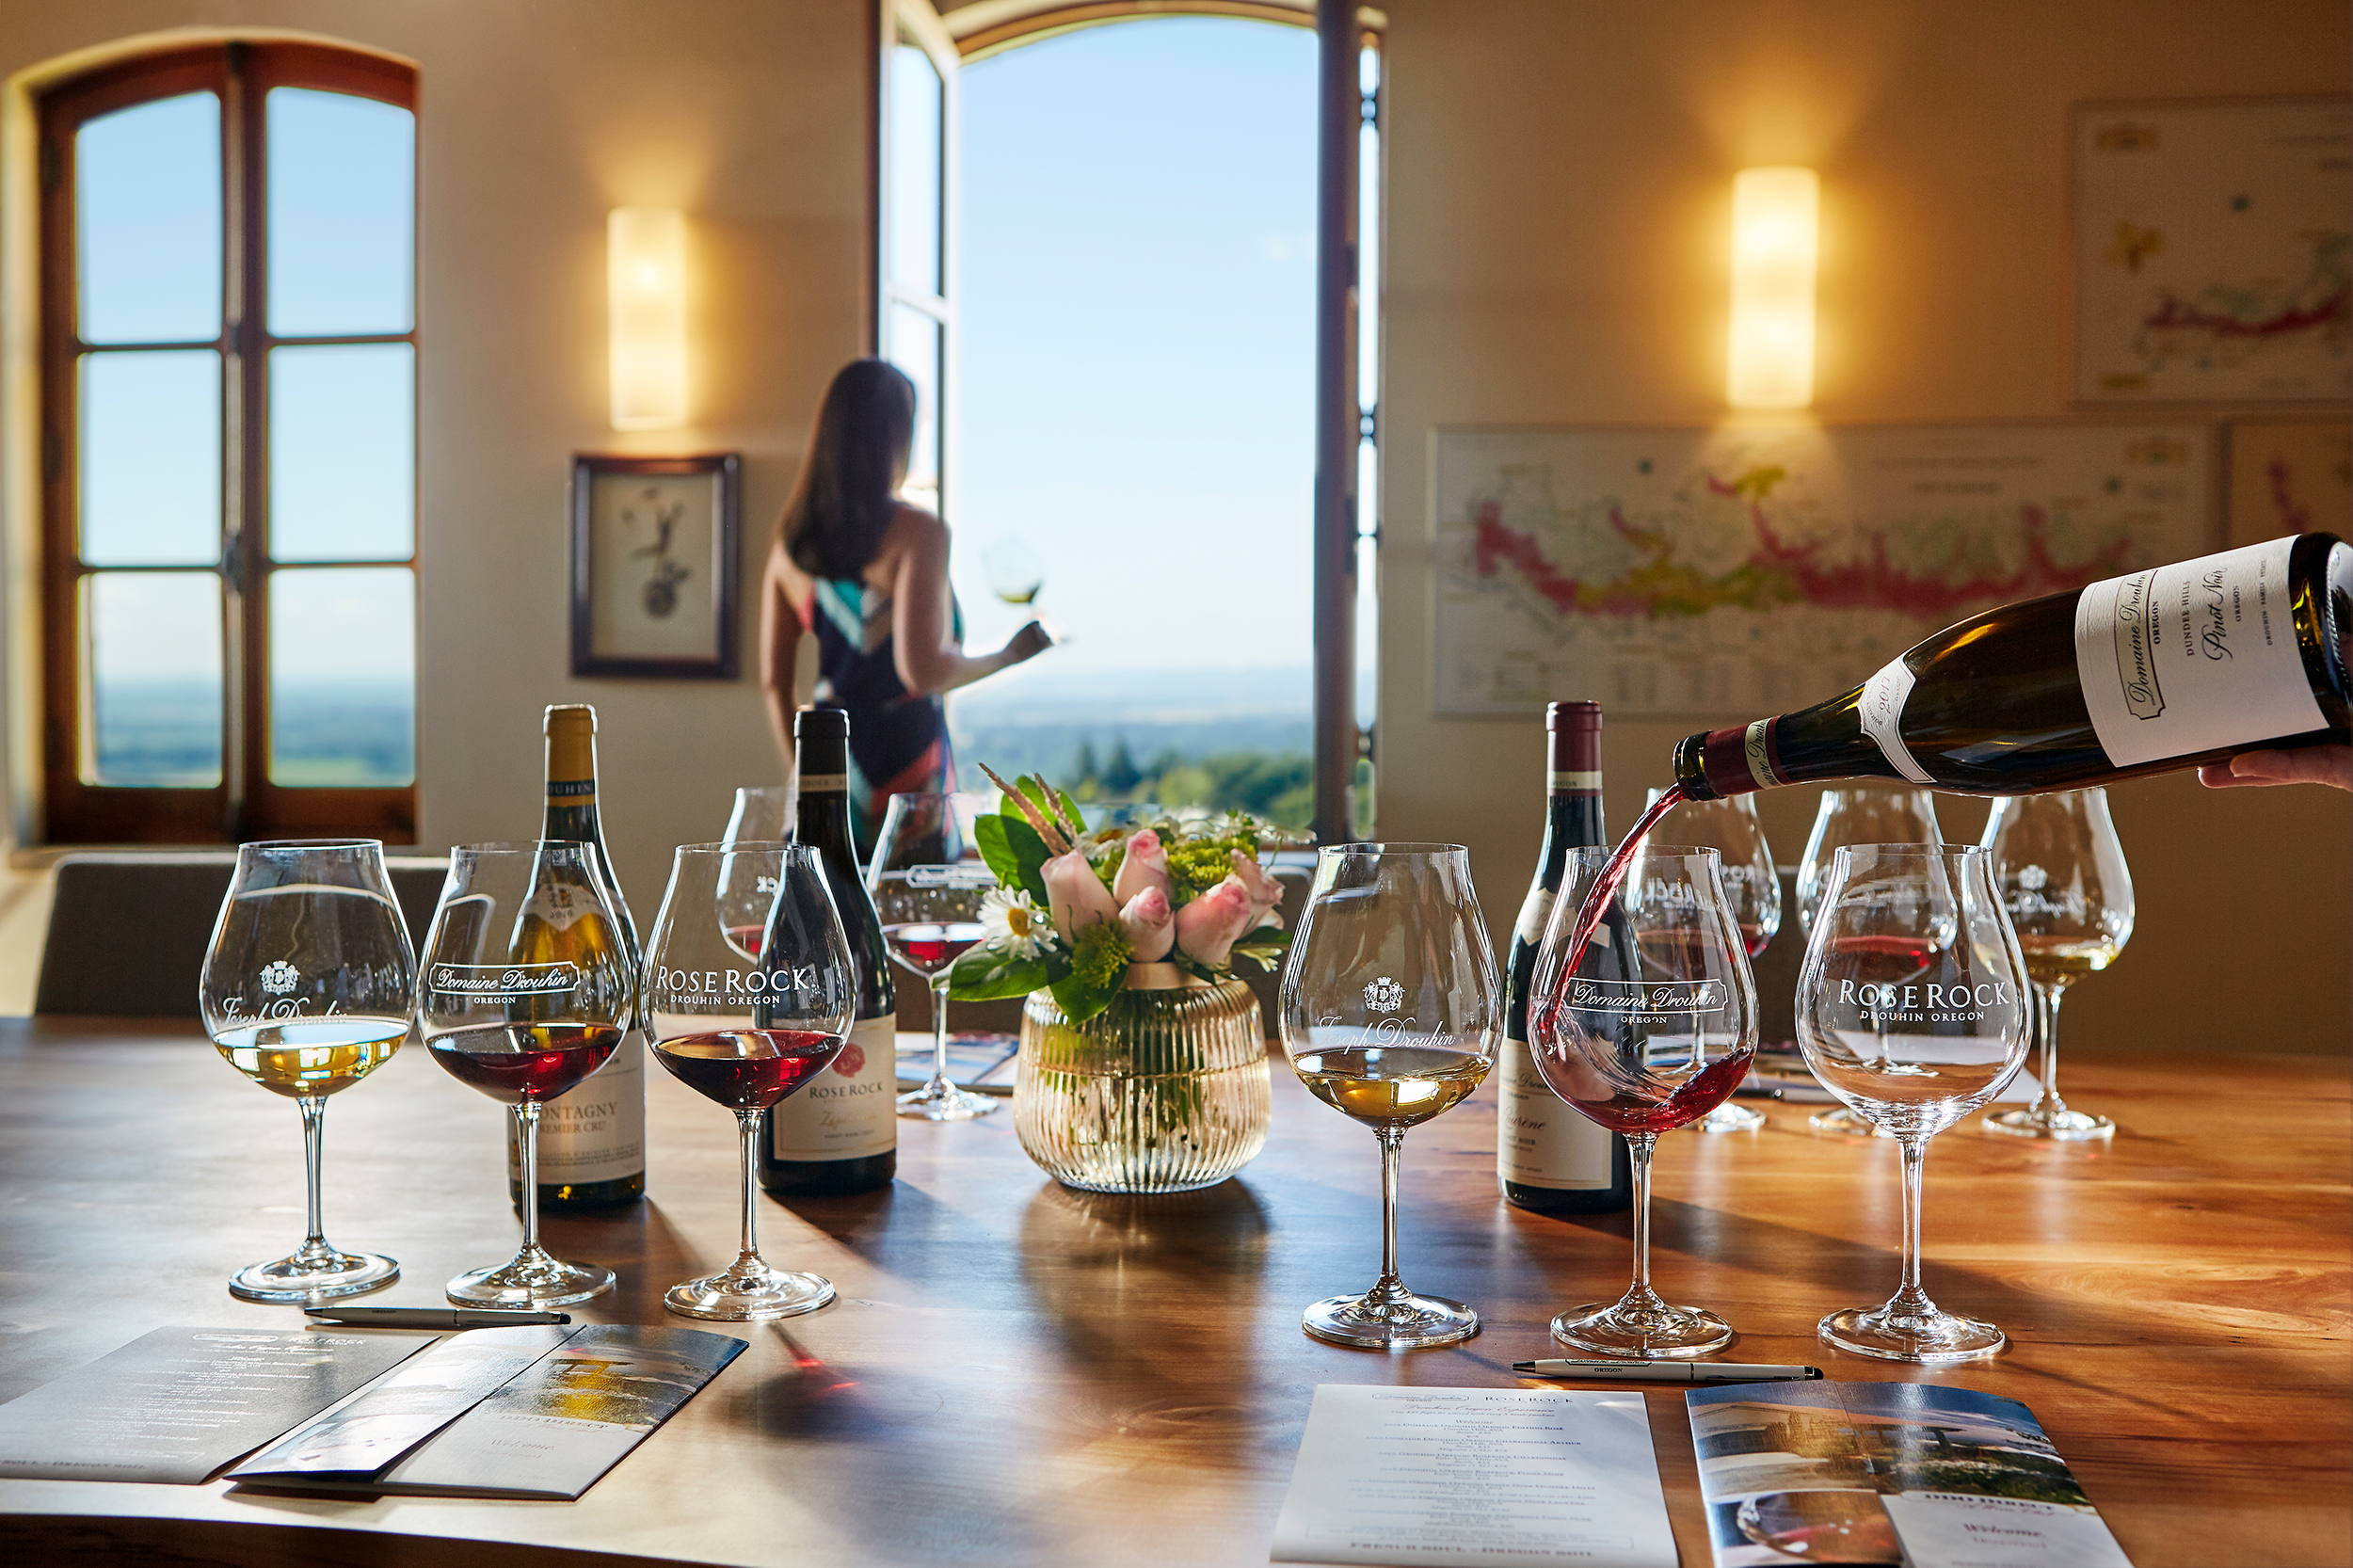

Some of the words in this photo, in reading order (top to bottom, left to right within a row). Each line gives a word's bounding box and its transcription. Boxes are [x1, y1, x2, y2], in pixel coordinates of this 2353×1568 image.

[2182, 581, 2191, 607] HILLS
[2202, 568, 2228, 605] Noir
[2233, 584, 2242, 622] OREGON
[2153, 600, 2161, 645] OREGON
[2182, 609, 2195, 657] DUNDEE
[2201, 603, 2233, 662] Pinot
[2128, 626, 2155, 706] Domaine
[1879, 676, 1892, 714] 2017
[436, 968, 499, 989] Domaine
[500, 968, 568, 989] Drouhin
[1574, 984, 1647, 1007] Domaine
[222, 997, 270, 1032] Joseph
[670, 994, 722, 1005] DROUHIN
[728, 995, 780, 1006] OREGON
[1930, 1011, 1985, 1022] OREGON
[1319, 1015, 1370, 1055] Joseph
[1374, 1016, 1455, 1048] Drouhin
[1620, 1016, 1668, 1024] OREGON
[540, 1101, 617, 1120] ONTAGNY
[538, 1123, 581, 1135] REMIER
